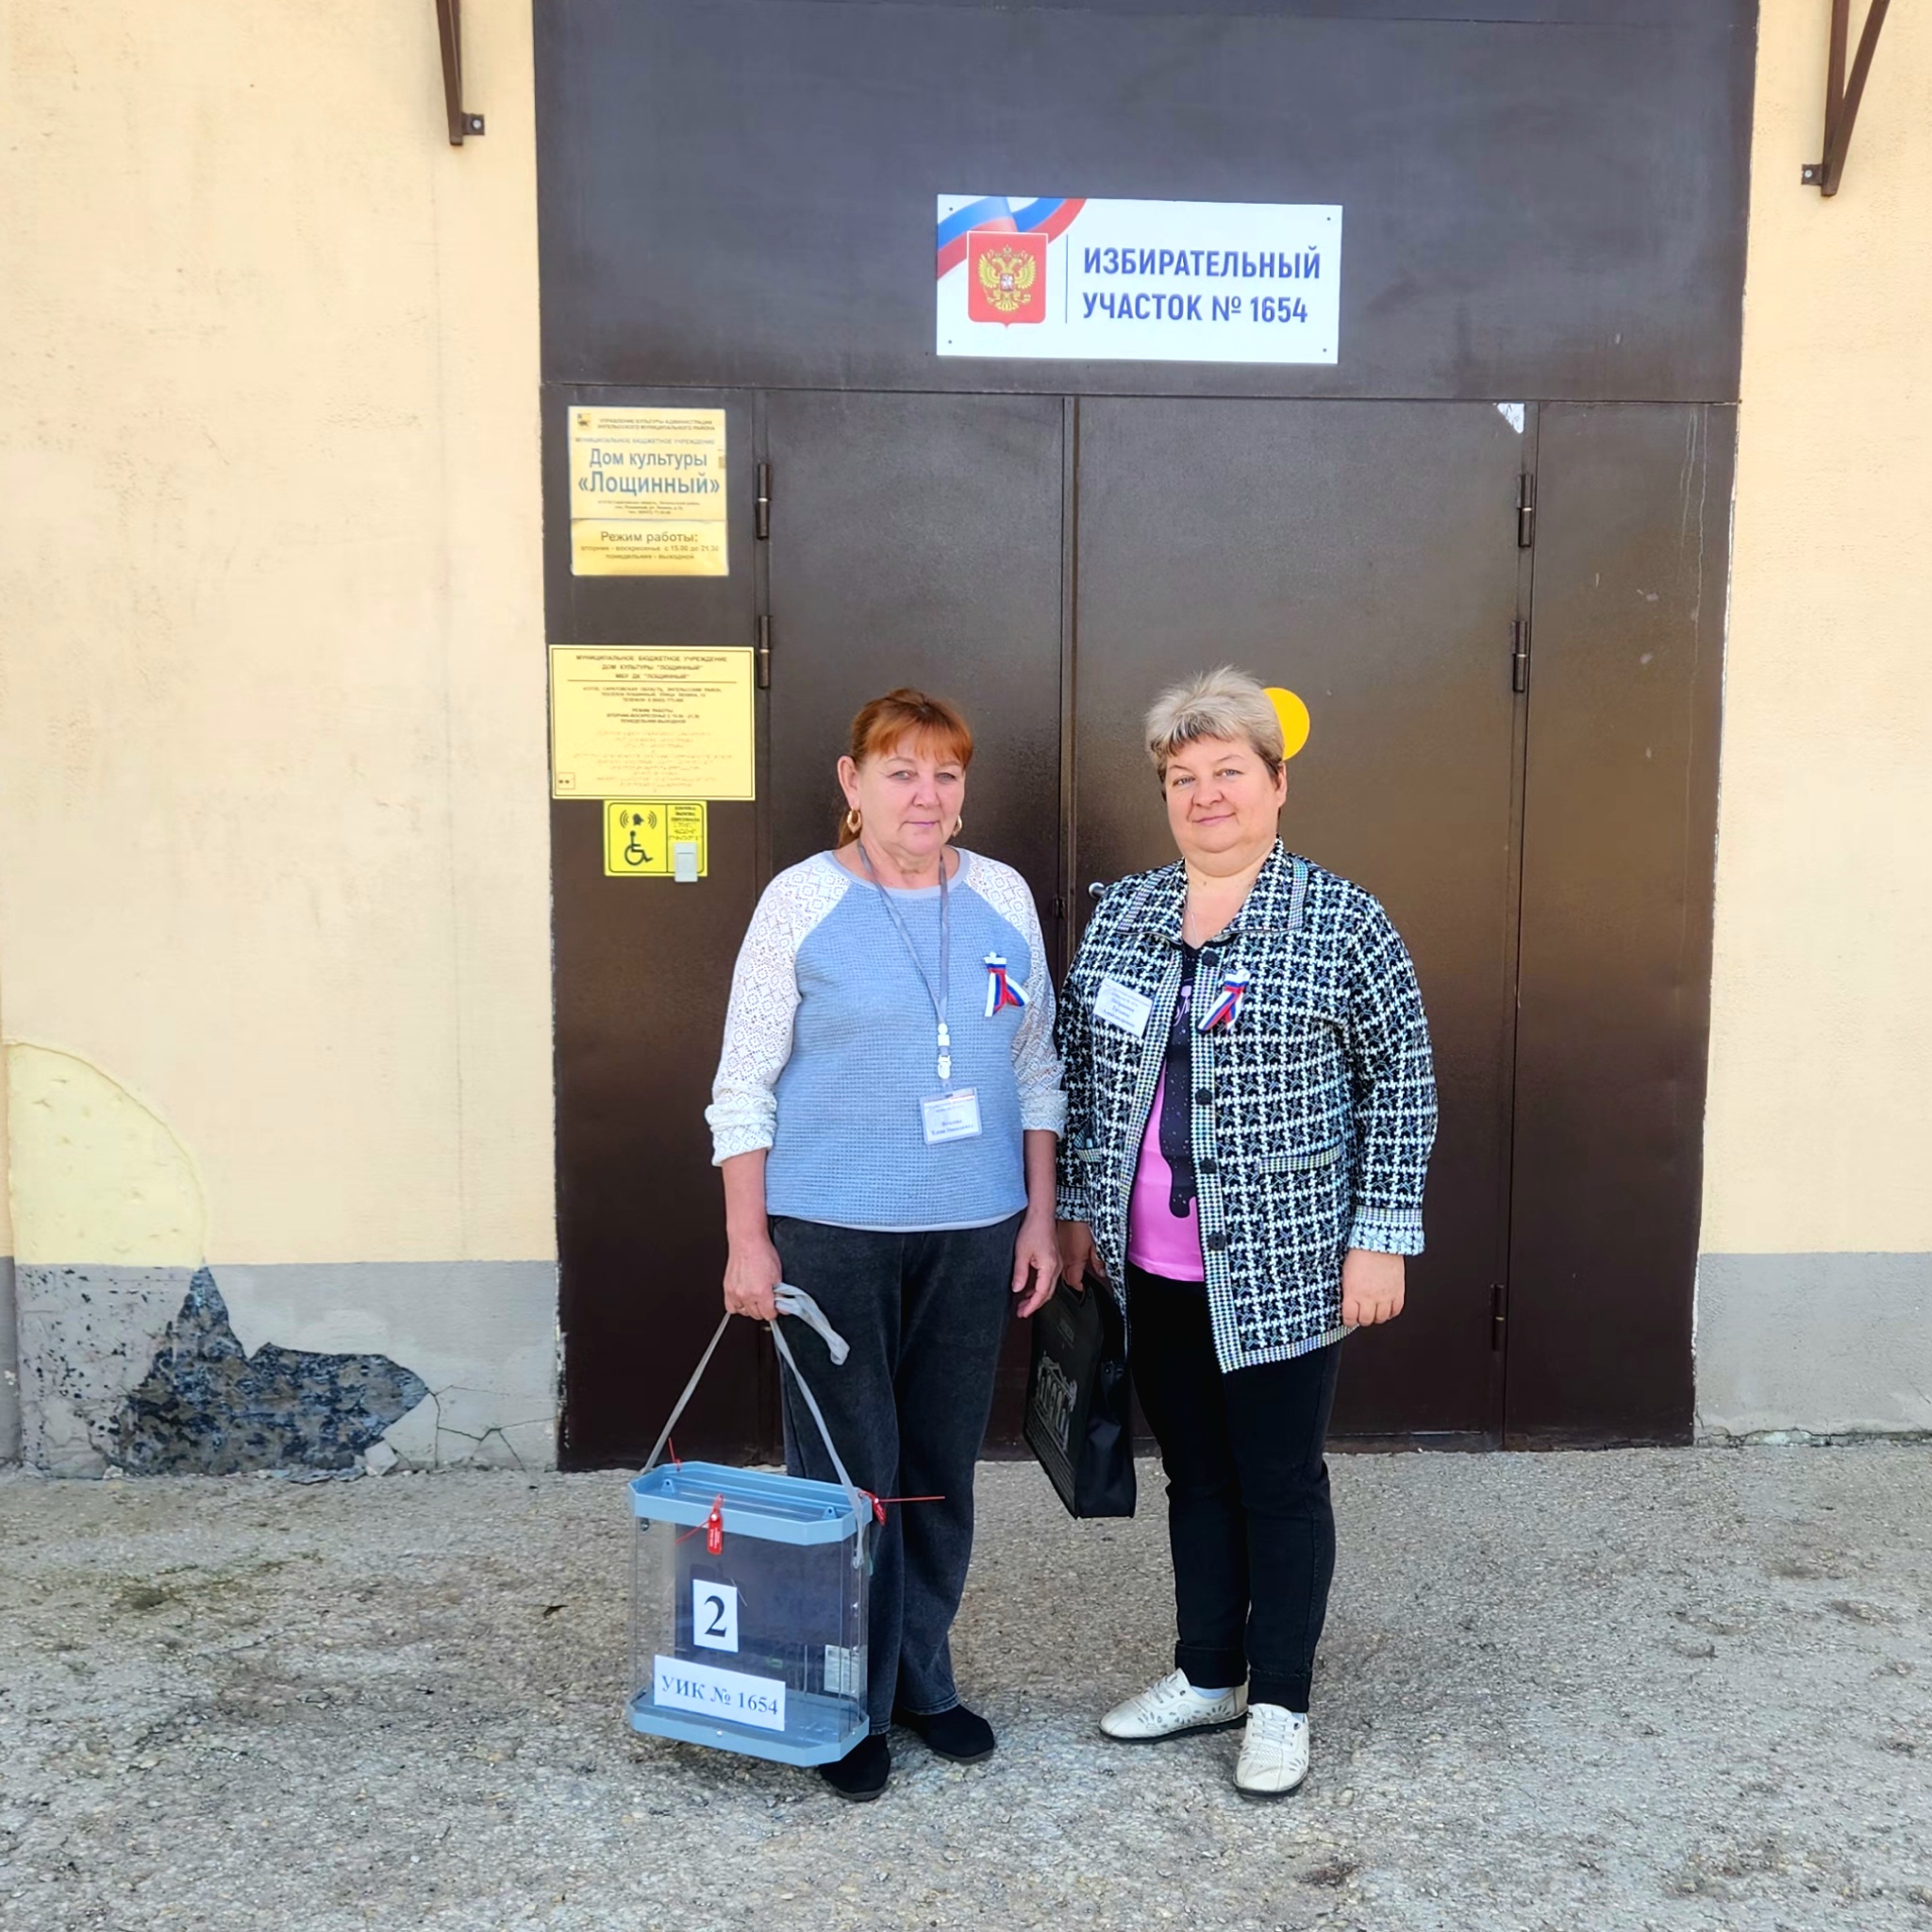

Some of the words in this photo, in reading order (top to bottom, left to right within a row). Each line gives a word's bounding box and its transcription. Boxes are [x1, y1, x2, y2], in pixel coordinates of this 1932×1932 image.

[1083, 244, 1321, 279] ИЗБИРАТЕЛЬНЫЙ
[1082, 292, 1203, 321] УЧАСТОК
[1211, 295, 1241, 322] №
[1250, 296, 1308, 324] 1654
[590, 448, 624, 468] Дом
[629, 453, 708, 471] культуры
[577, 471, 720, 496] «Лощинный»
[601, 531, 642, 542] Режим
[646, 531, 699, 544] работы:
[704, 1595, 727, 1638] 2
[661, 1674, 705, 1700] УИК
[710, 1686, 731, 1707] №
[739, 1691, 778, 1715] 1654
